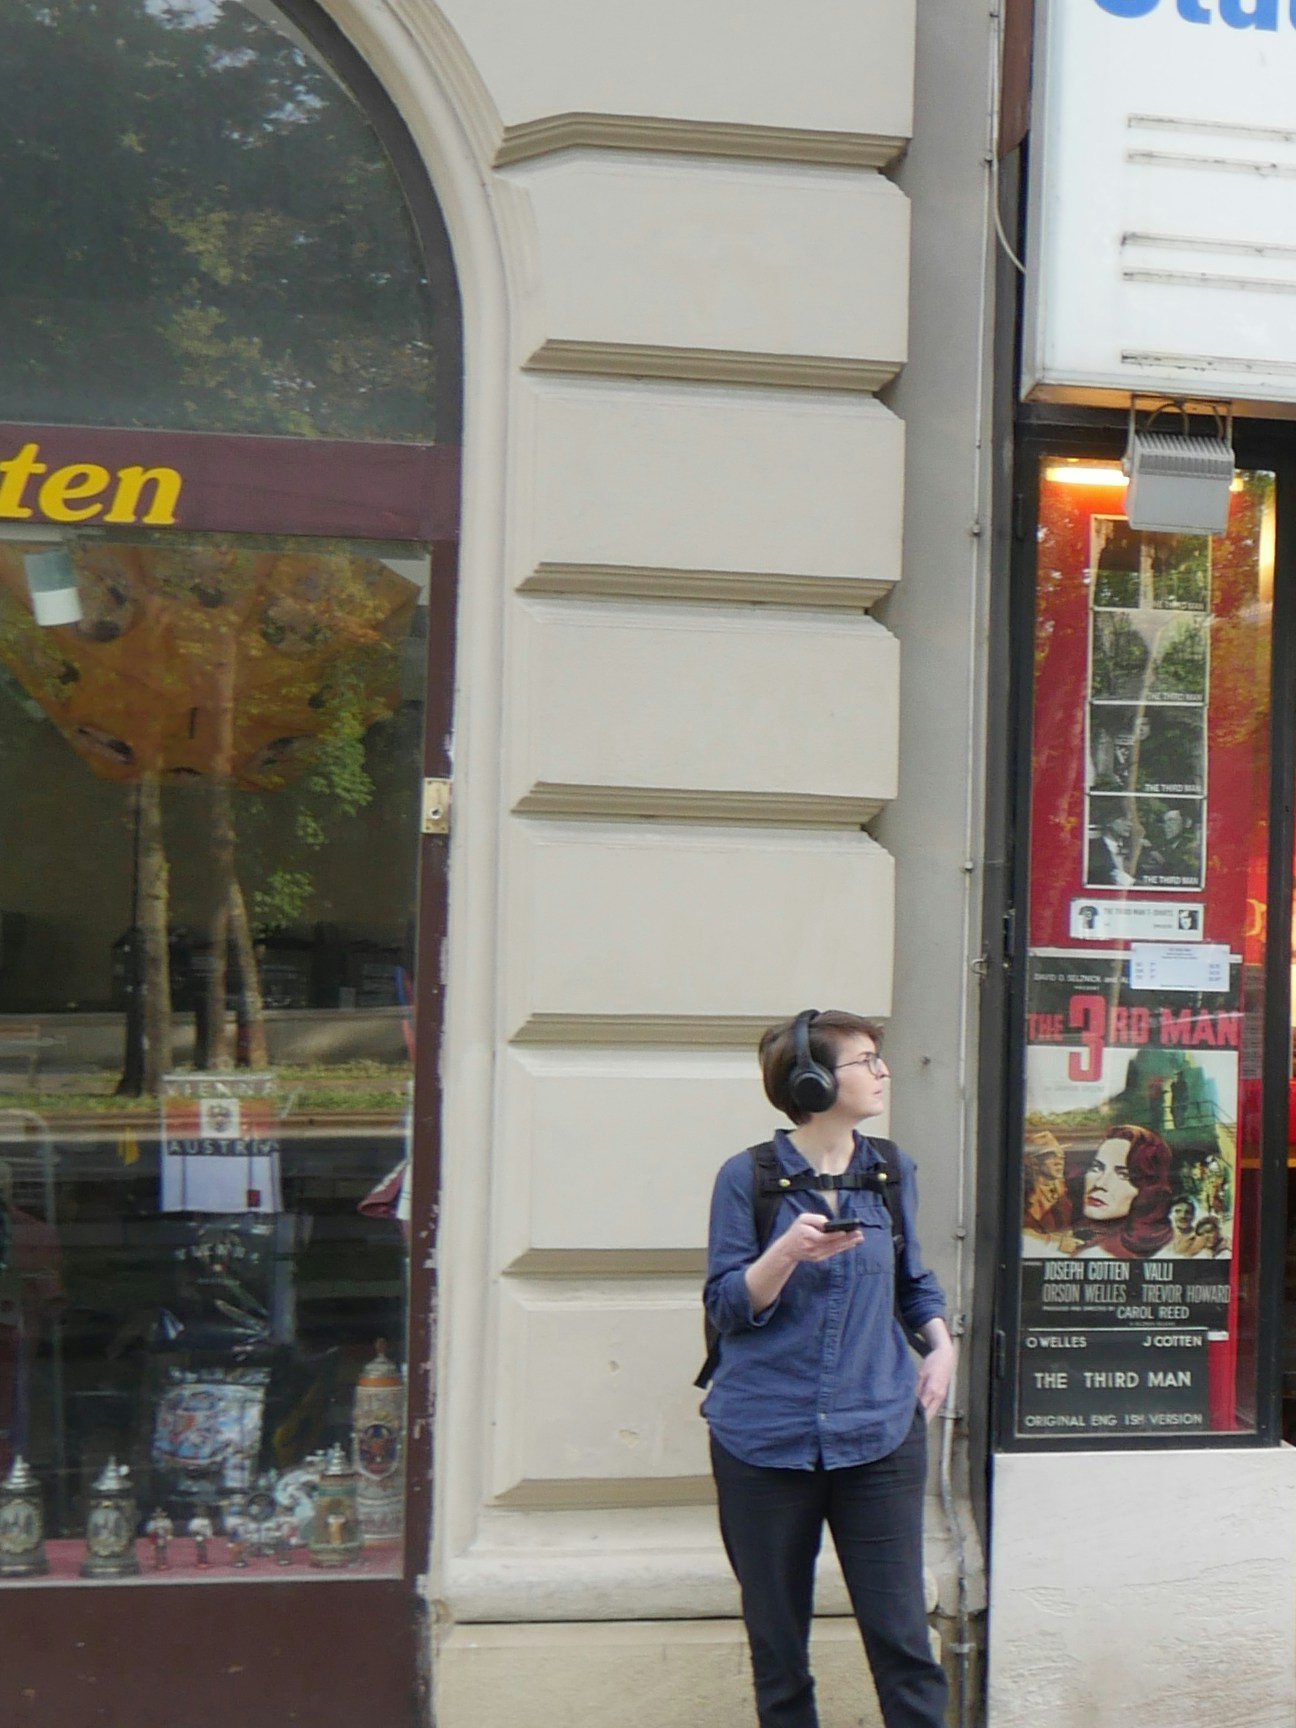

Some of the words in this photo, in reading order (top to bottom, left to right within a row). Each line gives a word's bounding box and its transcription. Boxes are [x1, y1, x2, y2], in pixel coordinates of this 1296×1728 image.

[0, 442, 183, 525] ten
[1028, 1013, 1064, 1042] THE
[1160, 1007, 1239, 1047] MAN
[166, 1139, 280, 1155] AUSTRIA
[1044, 1261, 1084, 1281] JOSEPH
[1087, 1261, 1130, 1281] COTTEN
[1143, 1262, 1174, 1282] VALLI
[1041, 1283, 1080, 1303] ORSON
[1085, 1283, 1127, 1303] WELLES
[1141, 1284, 1182, 1304] TREVOR
[1186, 1284, 1231, 1304] HOWARD
[1116, 1306, 1155, 1320] CAROL
[1158, 1306, 1190, 1320] REED
[1039, 1336, 1087, 1349] WELLES
[1153, 1335, 1203, 1348] COTTEN
[1034, 1372, 1069, 1389] THE
[1083, 1372, 1140, 1389] THIRD
[1147, 1370, 1193, 1388] MAN
[1024, 1414, 1086, 1427] ORIGINAL
[1149, 1413, 1203, 1426] VERSION
